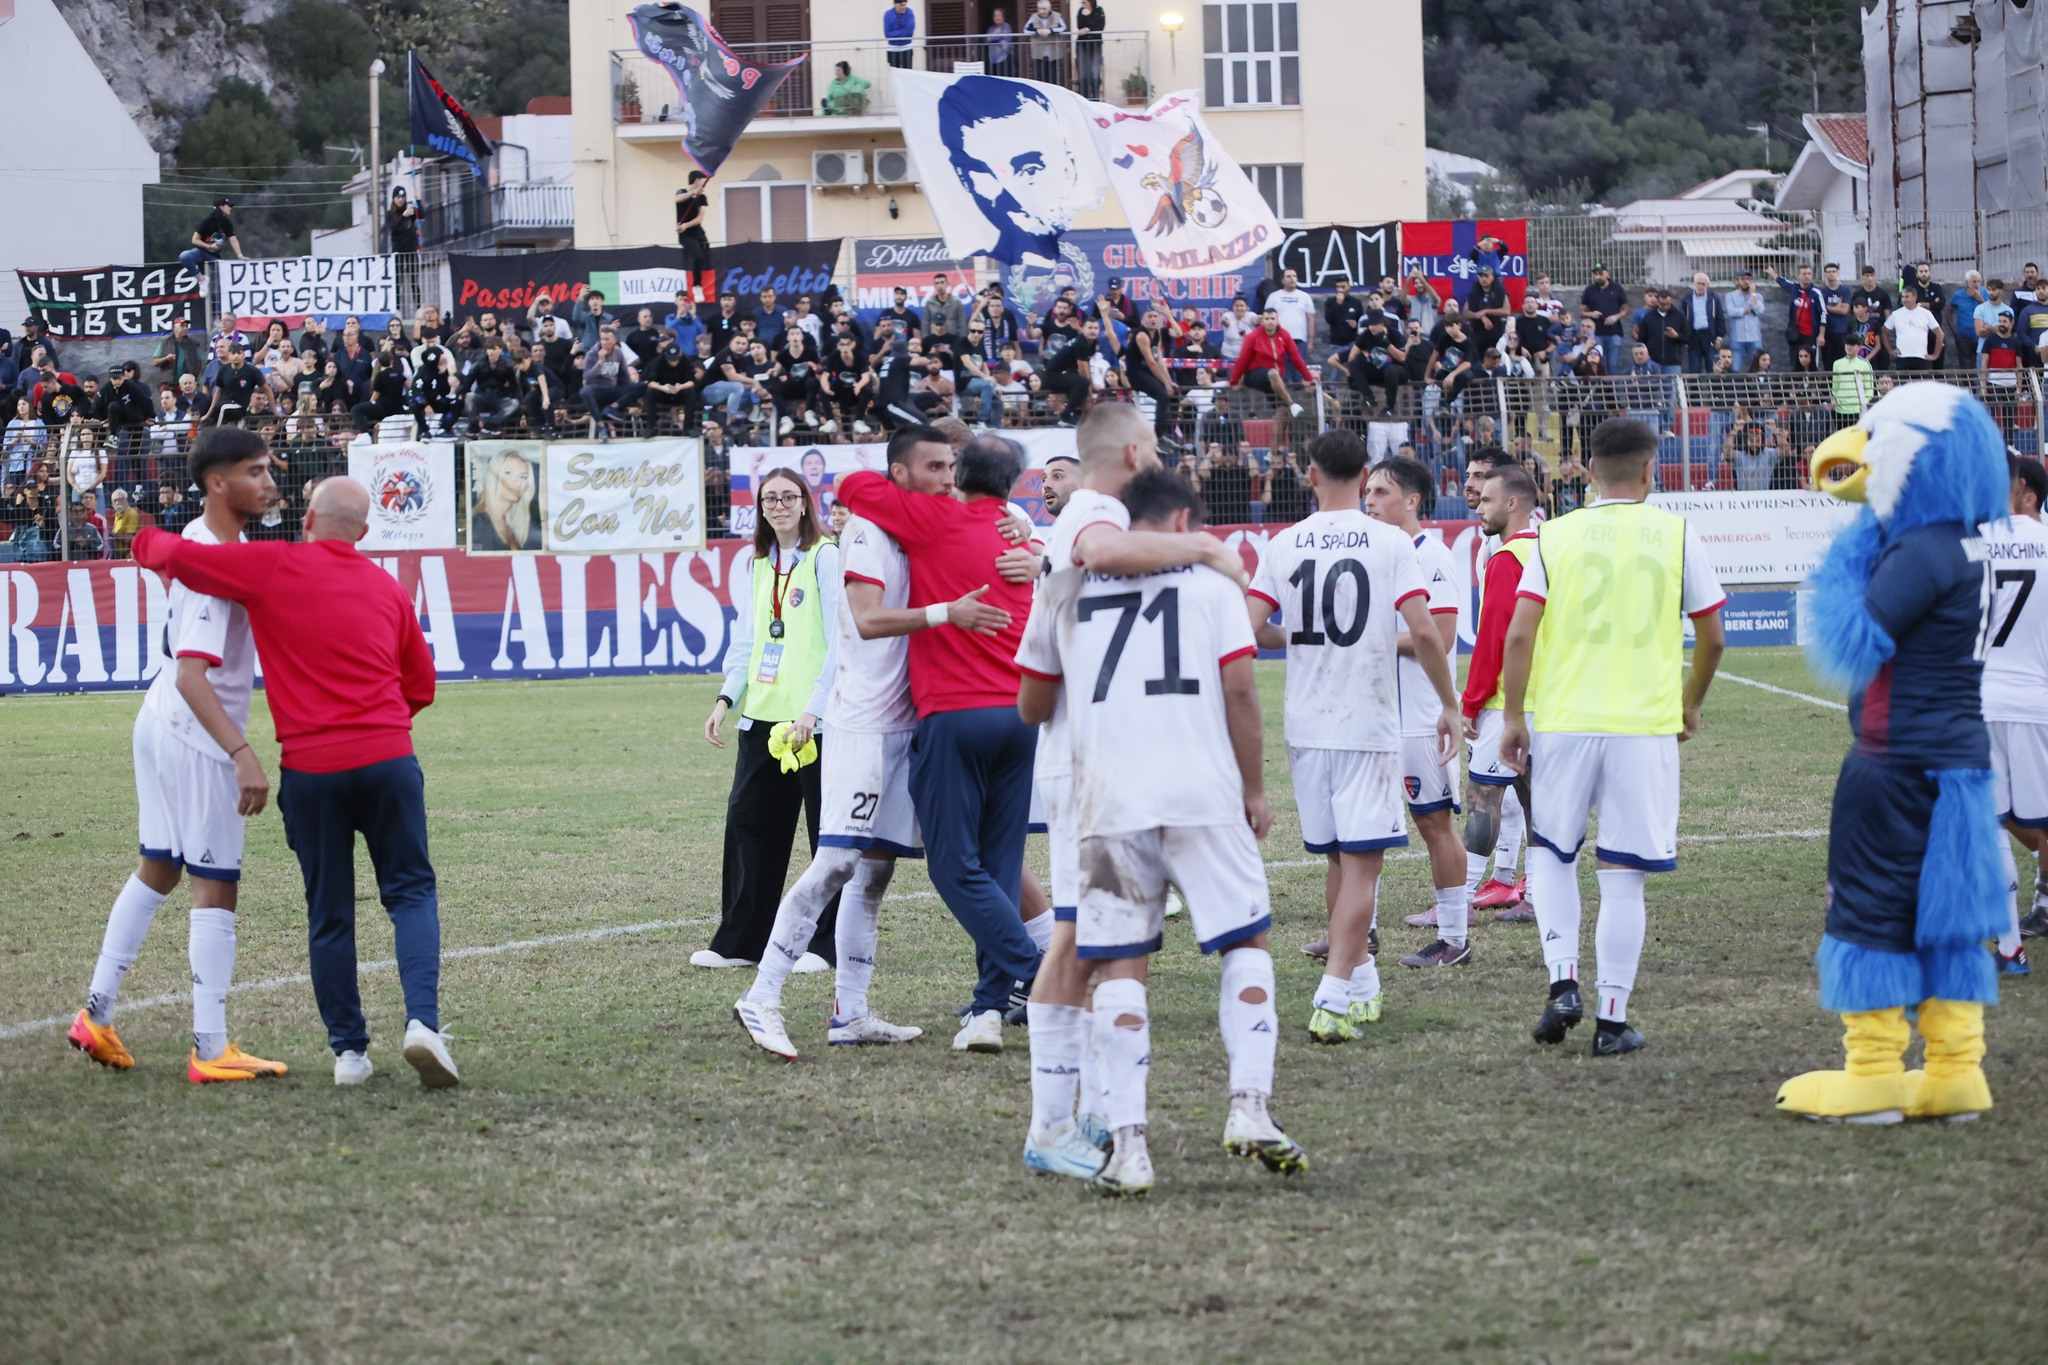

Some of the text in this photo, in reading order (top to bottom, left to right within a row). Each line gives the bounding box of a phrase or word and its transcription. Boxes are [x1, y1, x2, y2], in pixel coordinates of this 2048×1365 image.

[1156, 224, 1269, 271] MILAZZO
[22, 267, 198, 302] ULTRAS
[230, 254, 392, 286] DIFFIDATI
[722, 262, 831, 296] Fedeltà
[228, 284, 393, 315] PRESENTI
[459, 278, 587, 310] Passione
[622, 277, 684, 296] MILAZZO
[562, 452, 684, 498] Sempre
[553, 497, 620, 542] Con
[633, 493, 695, 535] Noi
[1295, 531, 1370, 551] LA SPADA
[1579, 523, 1664, 547] VERDURA
[1699, 532, 1771, 544] MMERGAS
[1985, 542, 2047, 560] RANCHINA
[1288, 557, 1371, 647] 10
[1562, 550, 1666, 650] 20
[1724, 618, 1789, 631] BERE SANO!
[1077, 587, 1200, 704] 71
[851, 791, 879, 821] 27
